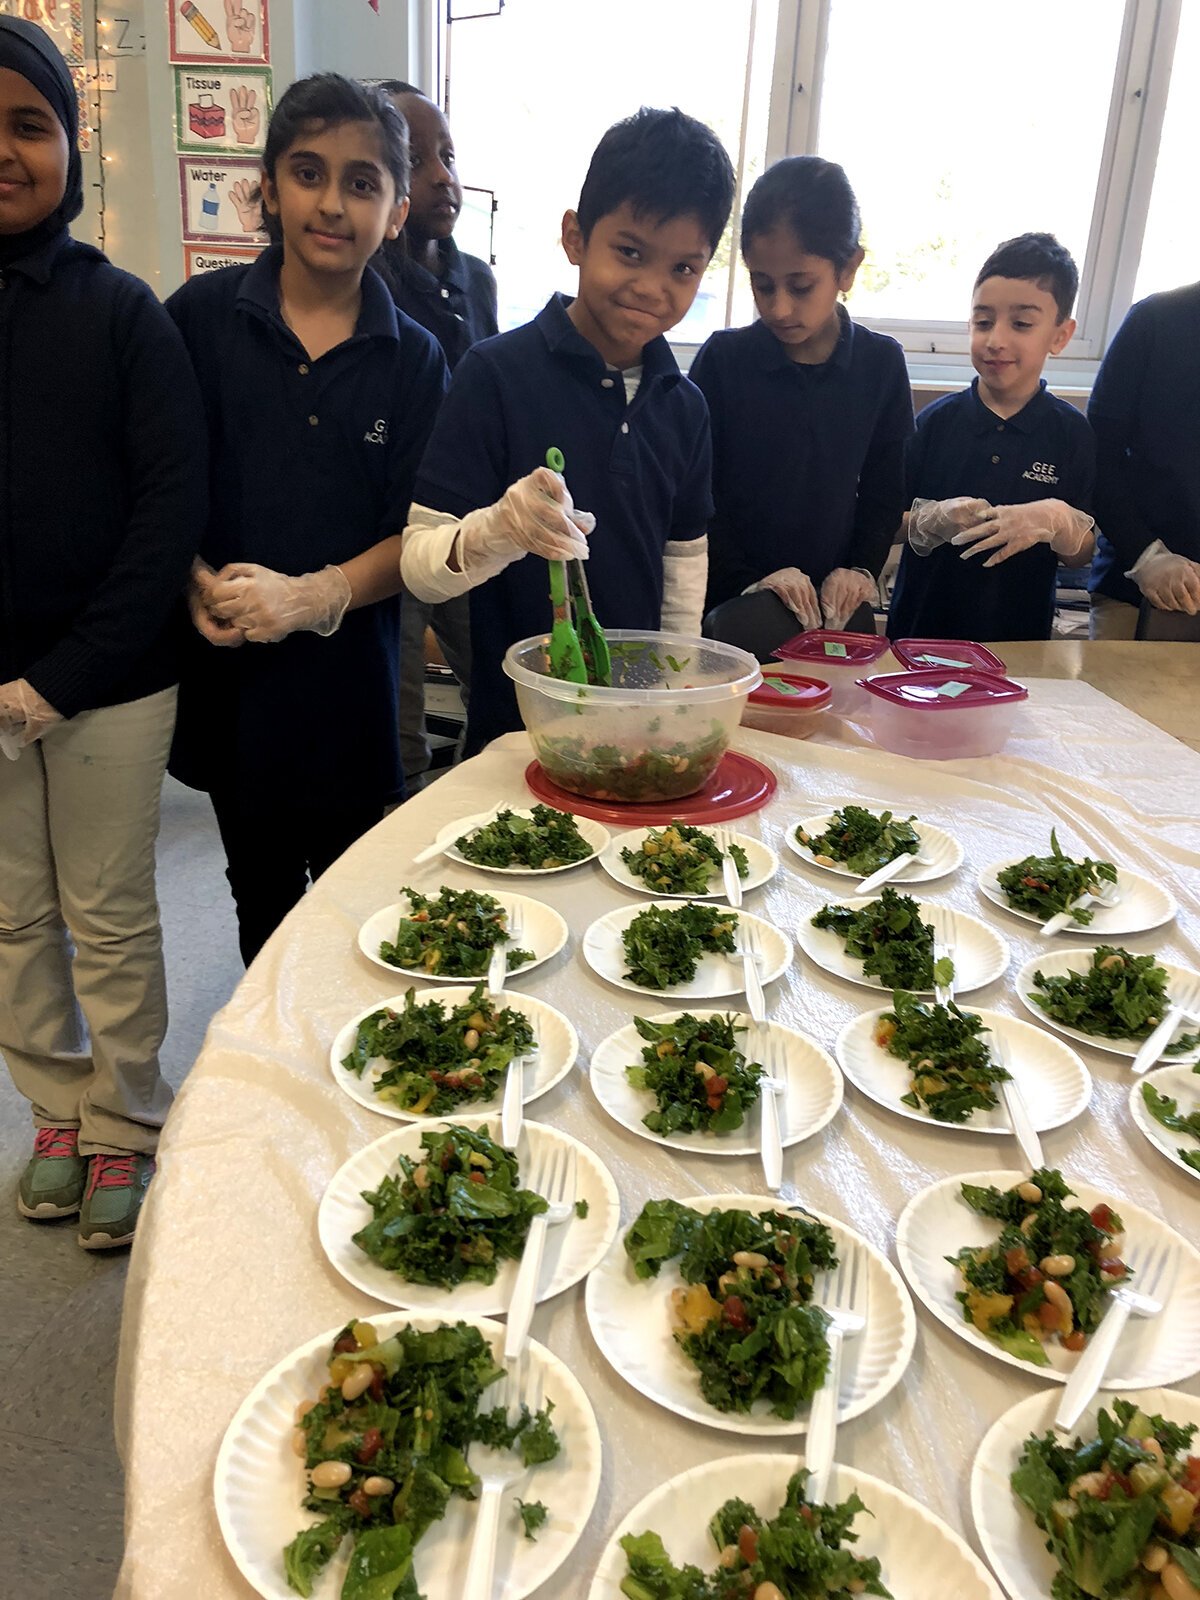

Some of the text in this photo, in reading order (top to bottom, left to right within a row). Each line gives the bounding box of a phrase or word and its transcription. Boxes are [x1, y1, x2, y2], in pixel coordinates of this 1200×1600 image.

[186, 77, 221, 90] Tissue
[191, 169, 228, 182] Water
[1032, 461, 1056, 475] GEE
[1022, 470, 1060, 485] ACADEMY
